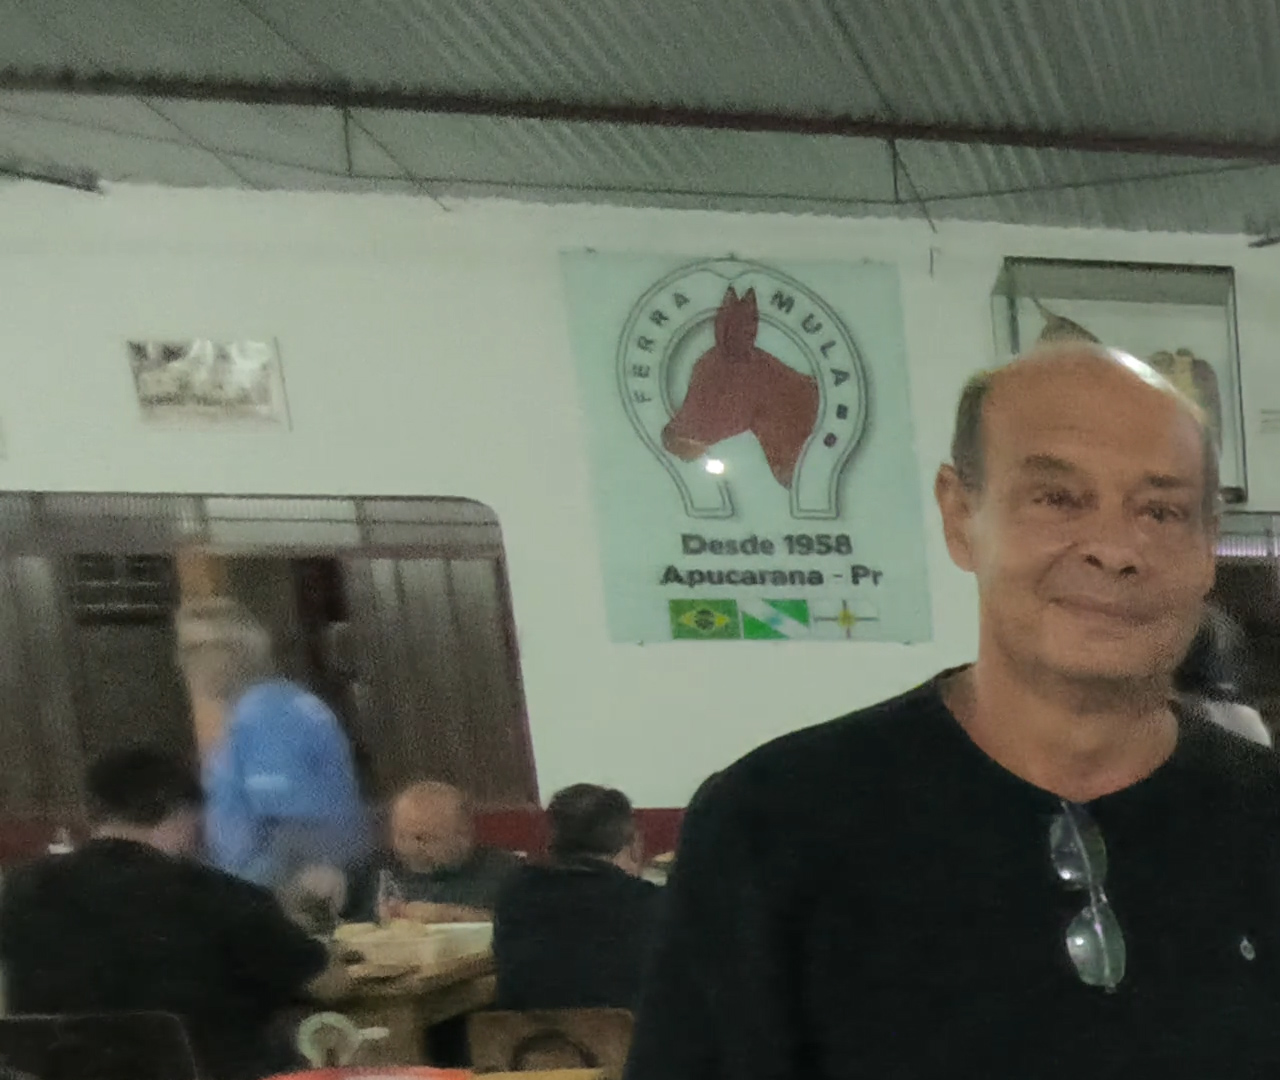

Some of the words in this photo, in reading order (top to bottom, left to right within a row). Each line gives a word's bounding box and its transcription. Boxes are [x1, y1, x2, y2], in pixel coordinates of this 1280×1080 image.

[632, 291, 690, 404] FERRA
[770, 290, 850, 387] MULA
[681, 533, 775, 556] Desde
[783, 533, 853, 556] 1958
[660, 563, 824, 588] Apucarana
[851, 564, 884, 587] Pr
